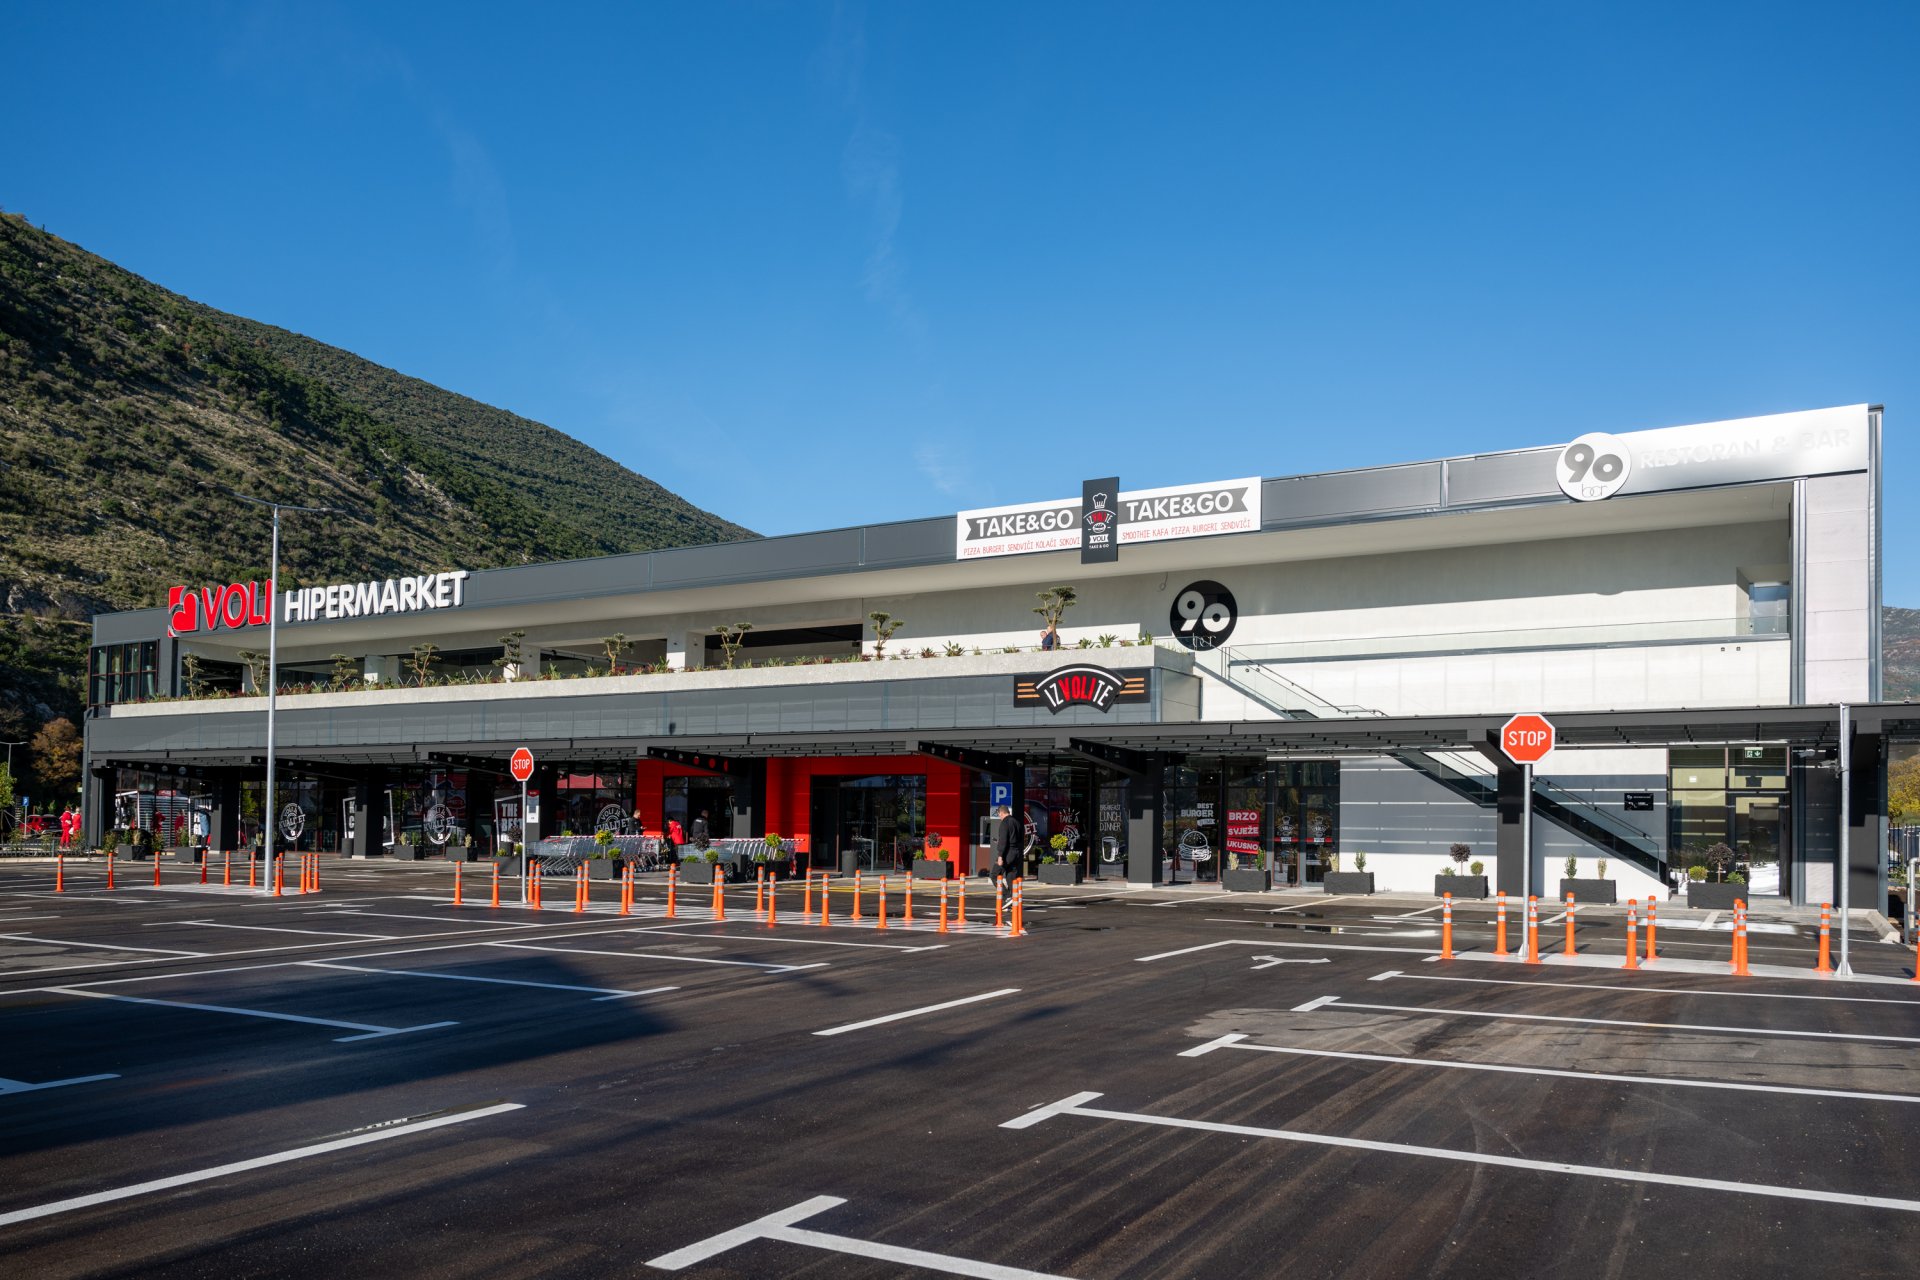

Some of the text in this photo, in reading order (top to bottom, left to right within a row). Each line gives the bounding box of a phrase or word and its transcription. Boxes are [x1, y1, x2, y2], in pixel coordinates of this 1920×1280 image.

[1640, 438, 1760, 469] RESTORAN
[1800, 428, 1850, 450] BAR
[1565, 443, 1624, 483] 90
[1126, 491, 1234, 521] TAKE&GO
[976, 509, 1074, 537] TAKE&GO
[1122, 529, 1151, 540] SMOOTHIE
[1152, 527, 1169, 537] KAFA
[1171, 525, 1190, 536] PIZZA
[1193, 522, 1218, 533] BURGERI
[963, 546, 981, 556] PIZZA
[982, 544, 1005, 554] BURGERI
[201, 570, 471, 631] VOLI HIPERMARKET
[1177, 590, 1231, 632] 90
[1044, 675, 1113, 708] IZVOLITE
[1508, 730, 1547, 746] STOP
[514, 758, 531, 770] STOP
[995, 785, 1007, 803] P
[501, 803, 518, 817] THE
[1099, 811, 1122, 822] LUNCH
[1181, 809, 1214, 817] BURGER
[1228, 811, 1258, 821] BRZO
[1099, 821, 1121, 832] DINNER
[1228, 825, 1259, 836] SVJEŽE
[1226, 840, 1259, 851] UKUSNO
